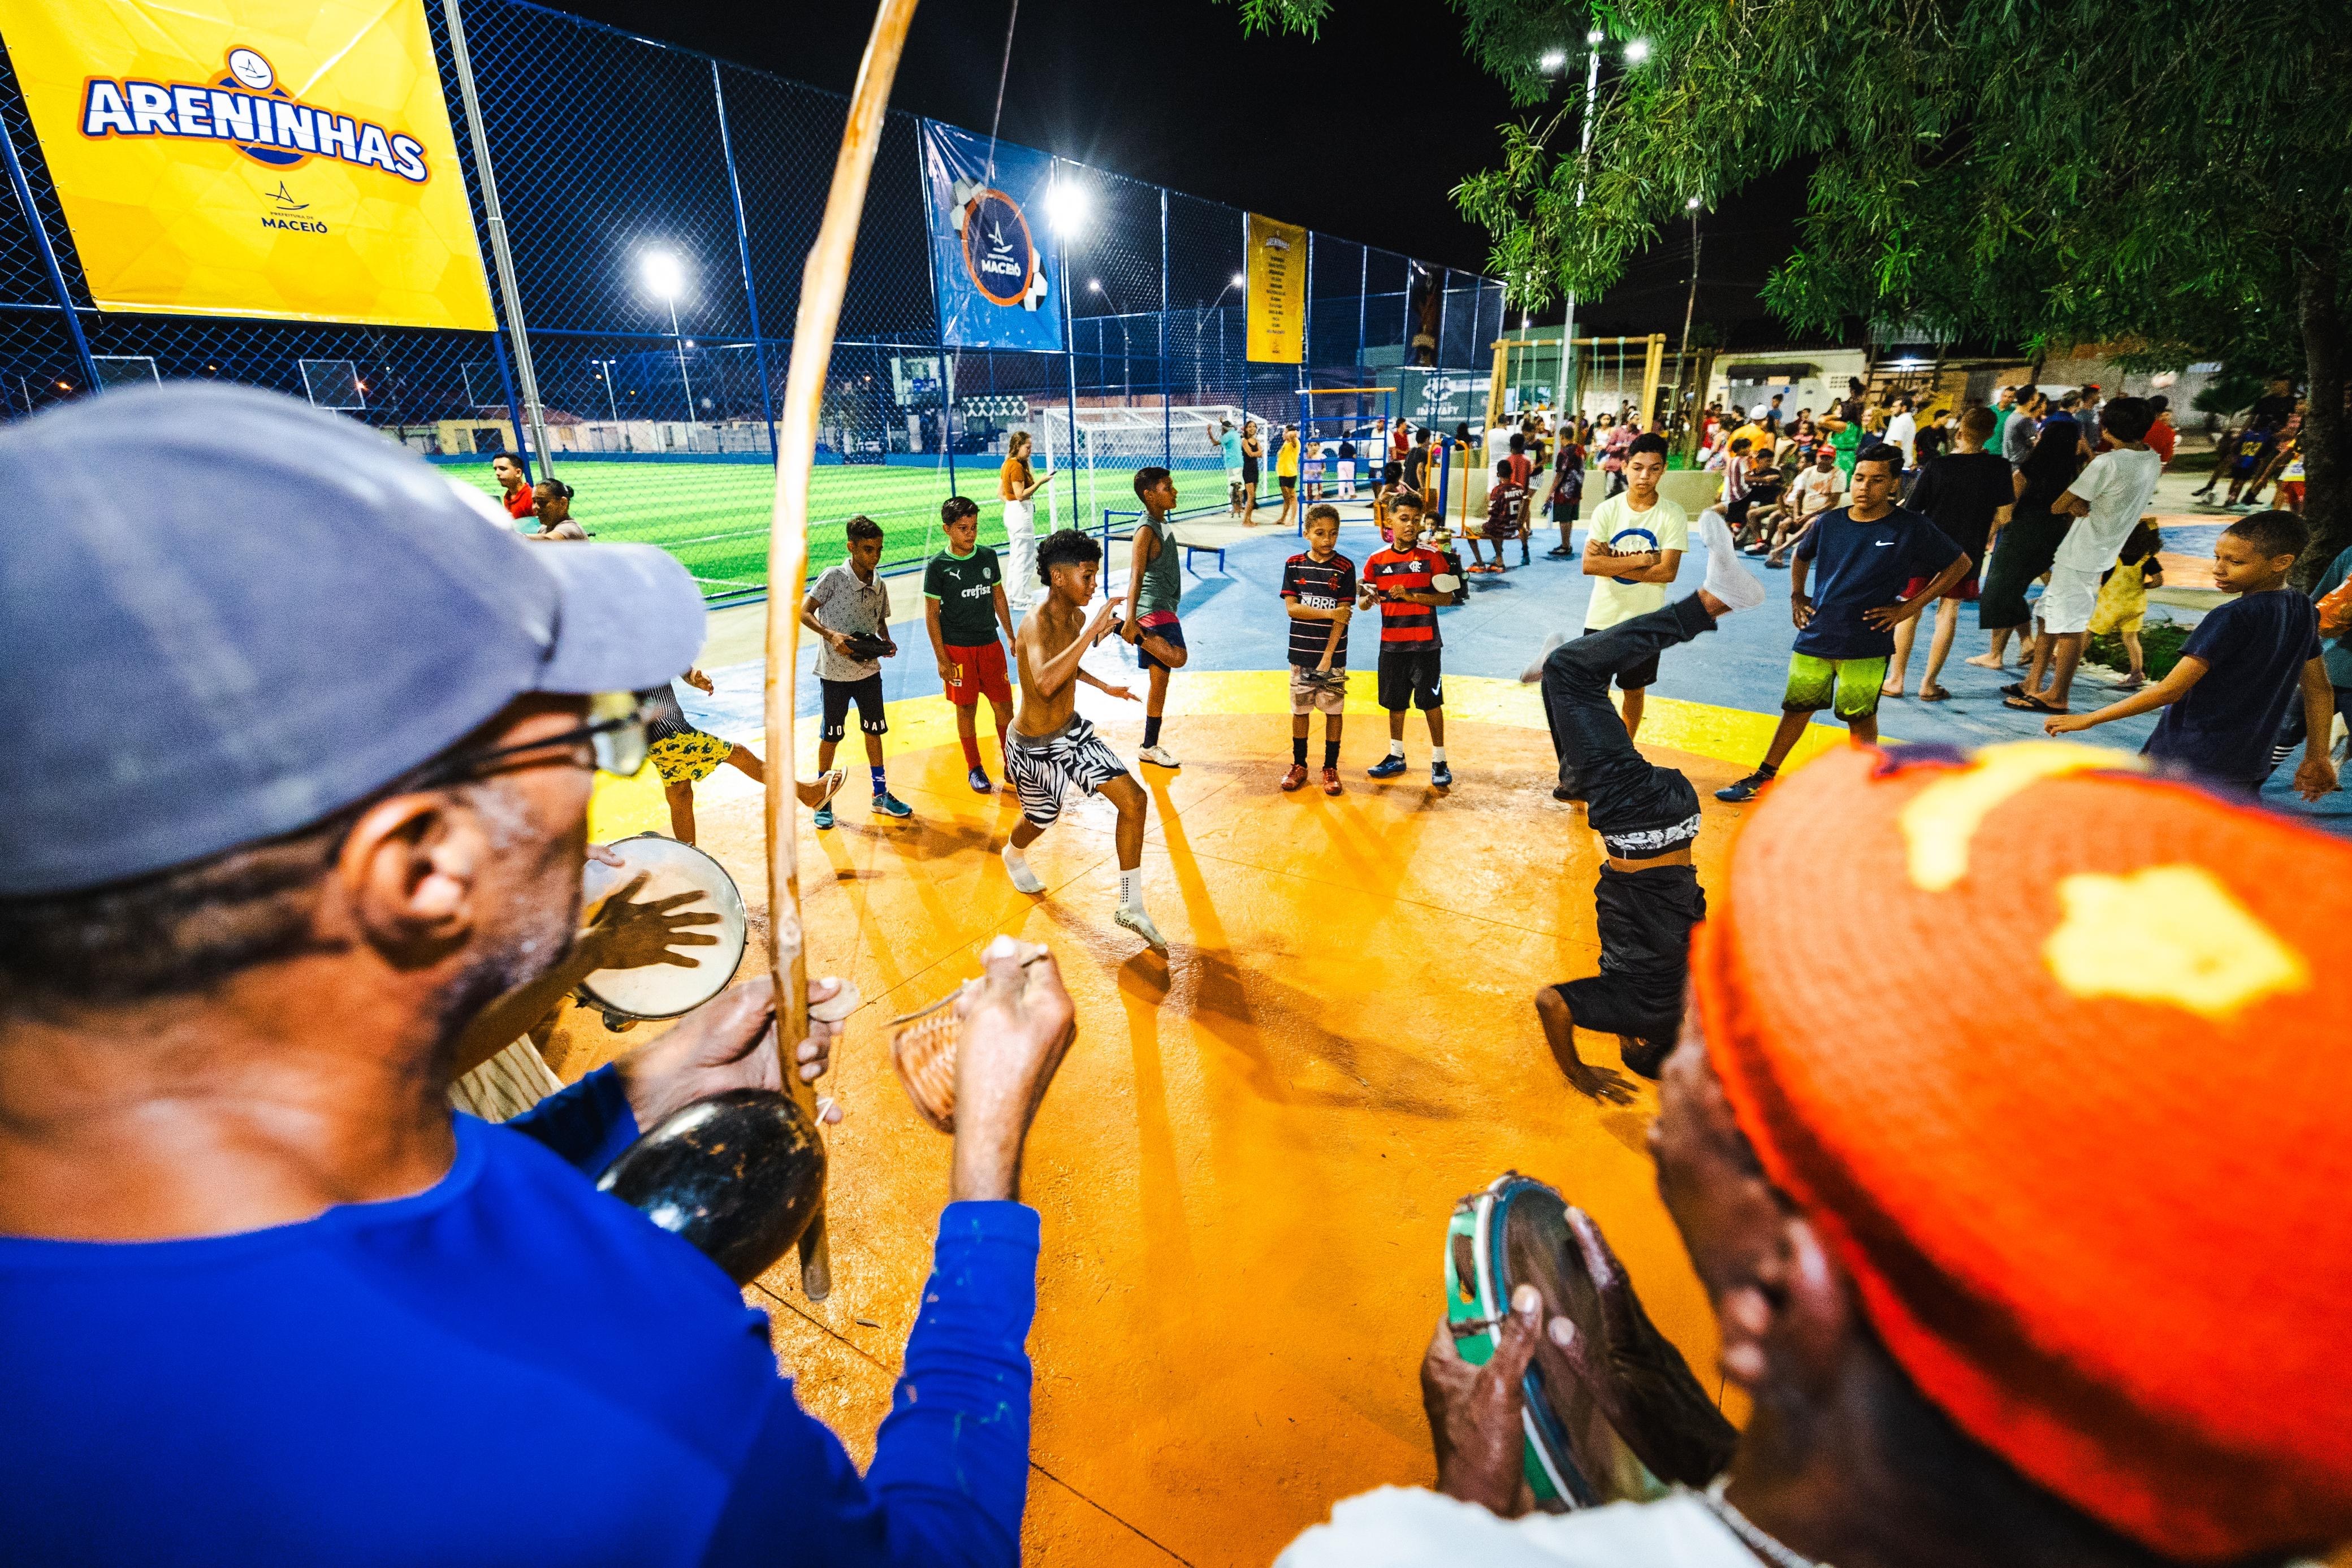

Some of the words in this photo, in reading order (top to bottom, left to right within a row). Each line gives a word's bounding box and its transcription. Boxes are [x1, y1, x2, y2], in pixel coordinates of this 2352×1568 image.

[86, 82, 427, 181] ARENINHAS
[261, 217, 328, 233] MACEIÓ
[981, 259, 1022, 277] MACEIÓ
[1312, 597, 1336, 610] BRB
